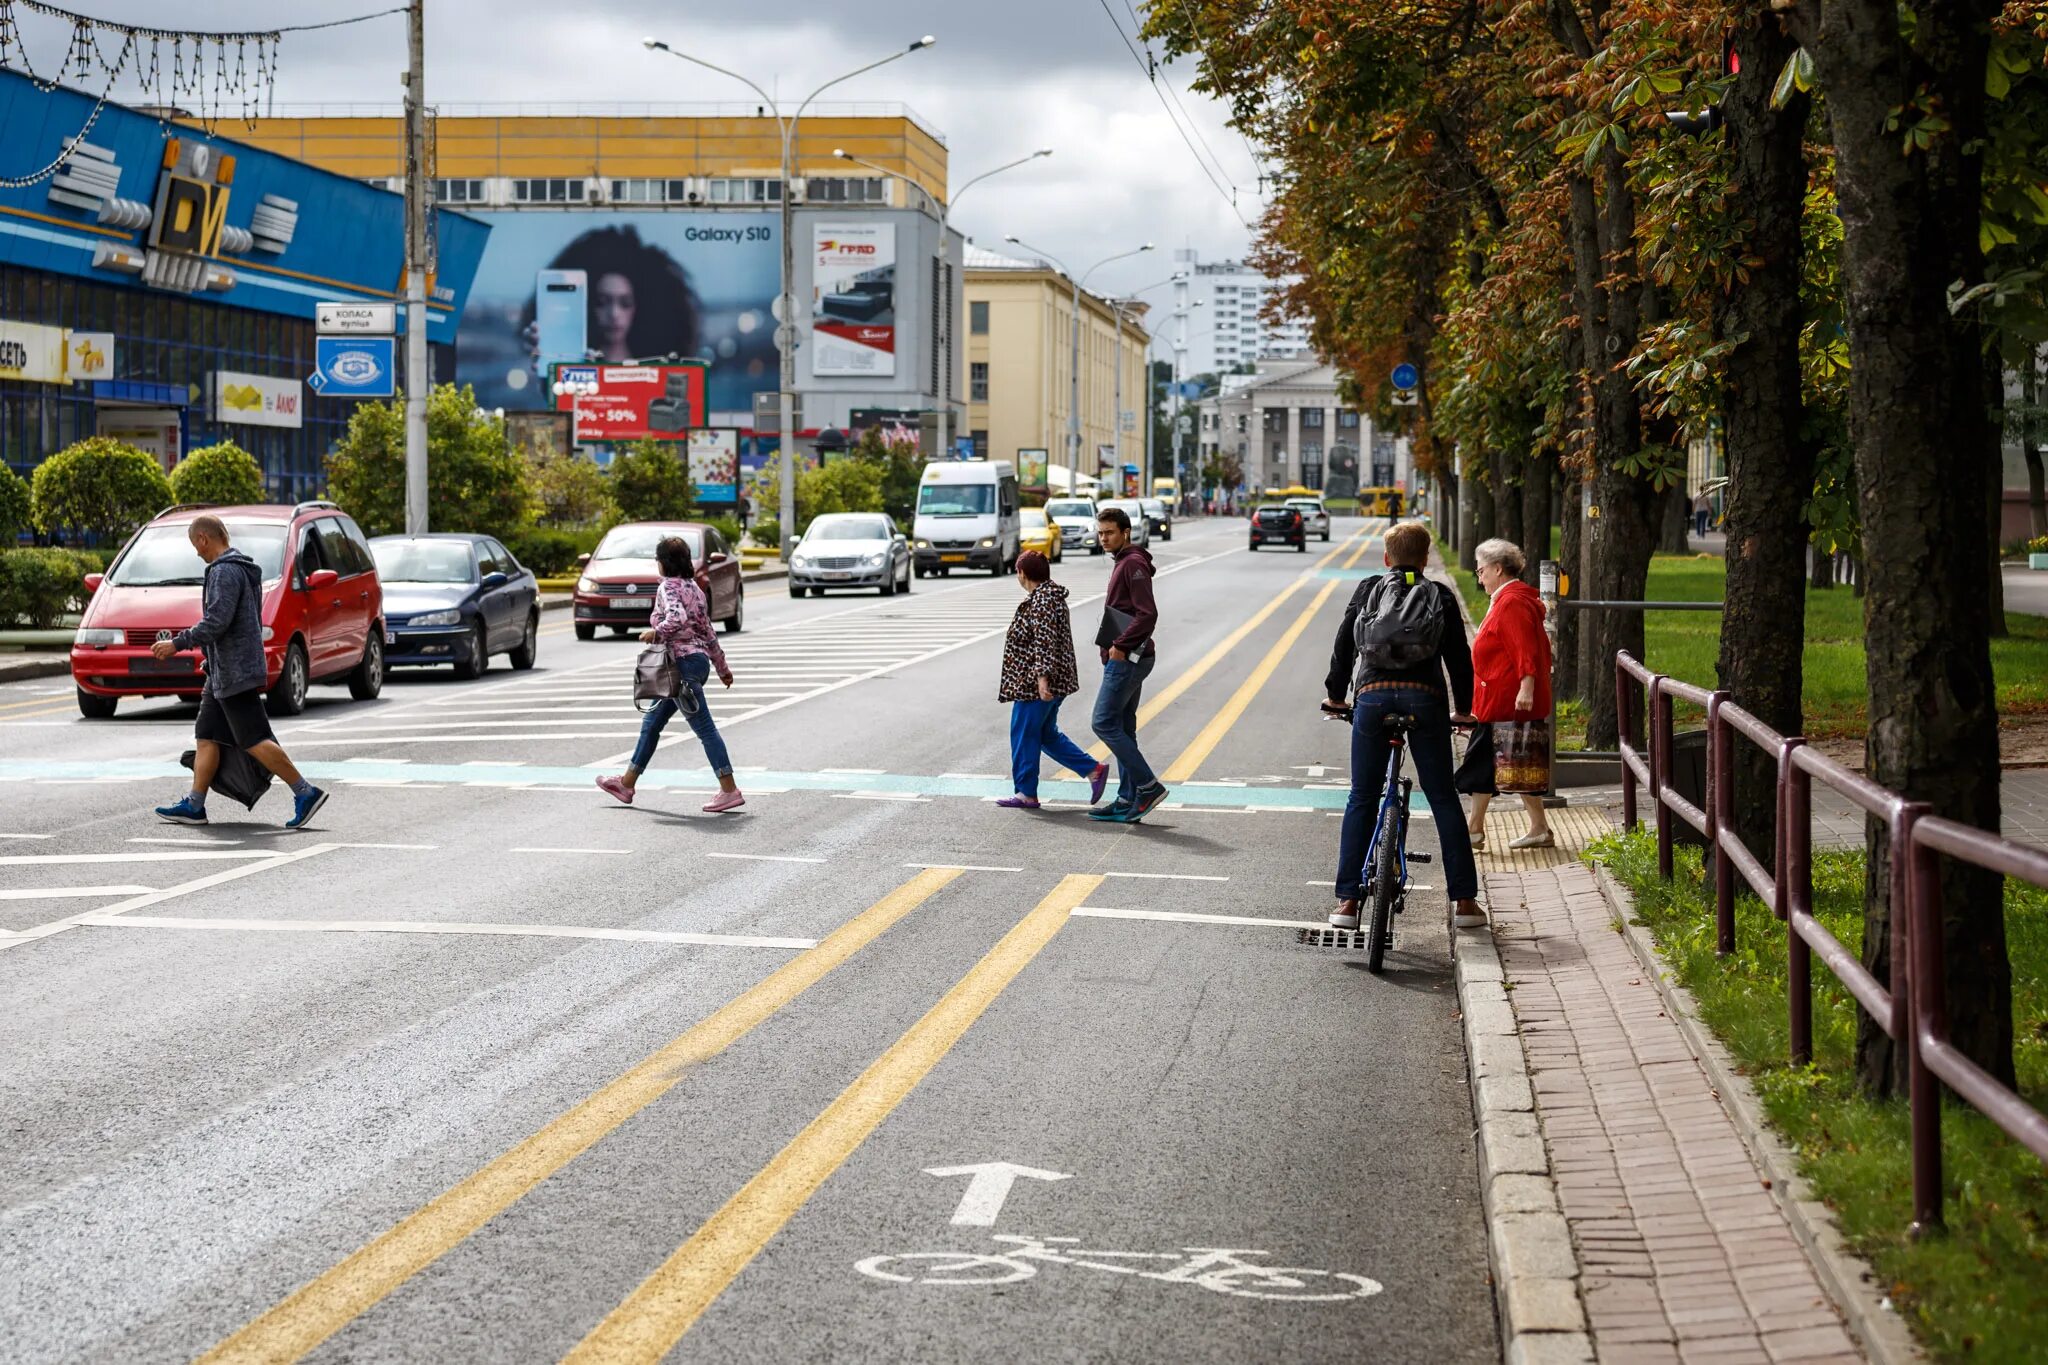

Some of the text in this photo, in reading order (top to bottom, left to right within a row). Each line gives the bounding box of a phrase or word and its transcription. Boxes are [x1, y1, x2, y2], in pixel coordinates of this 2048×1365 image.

[685, 227, 771, 244] Galaxy S10
[336, 310, 374, 319] КОЛАСА
[606, 409, 637, 422] 50%
